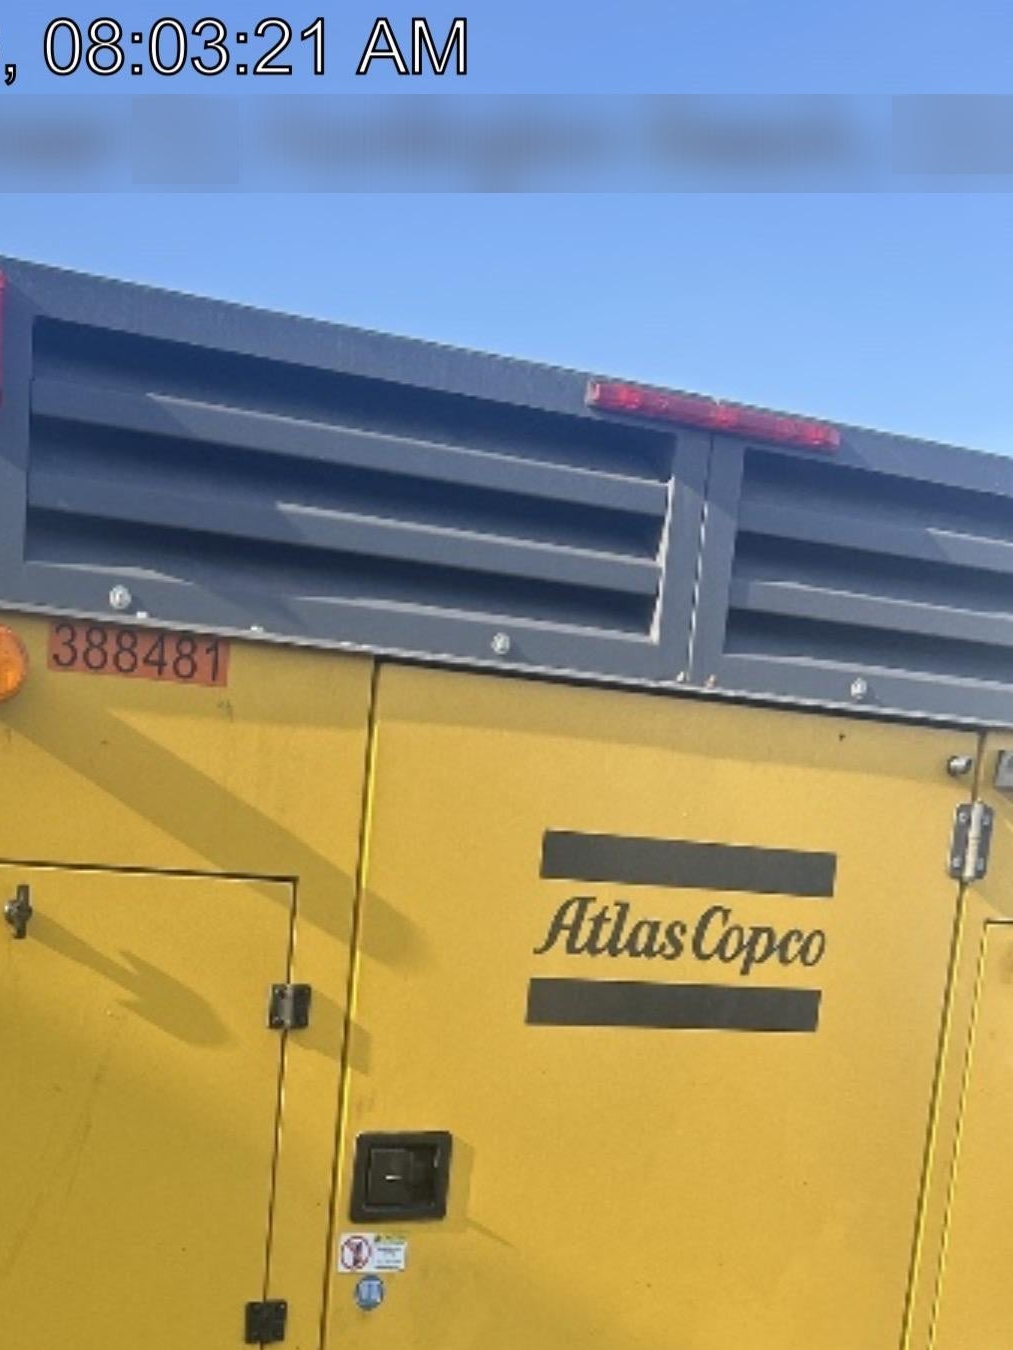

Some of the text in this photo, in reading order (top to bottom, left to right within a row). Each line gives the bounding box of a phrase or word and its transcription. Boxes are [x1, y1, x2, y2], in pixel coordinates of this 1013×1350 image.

[52, 623, 222, 682] 388481
[533, 896, 825, 975] Atlas Copco
